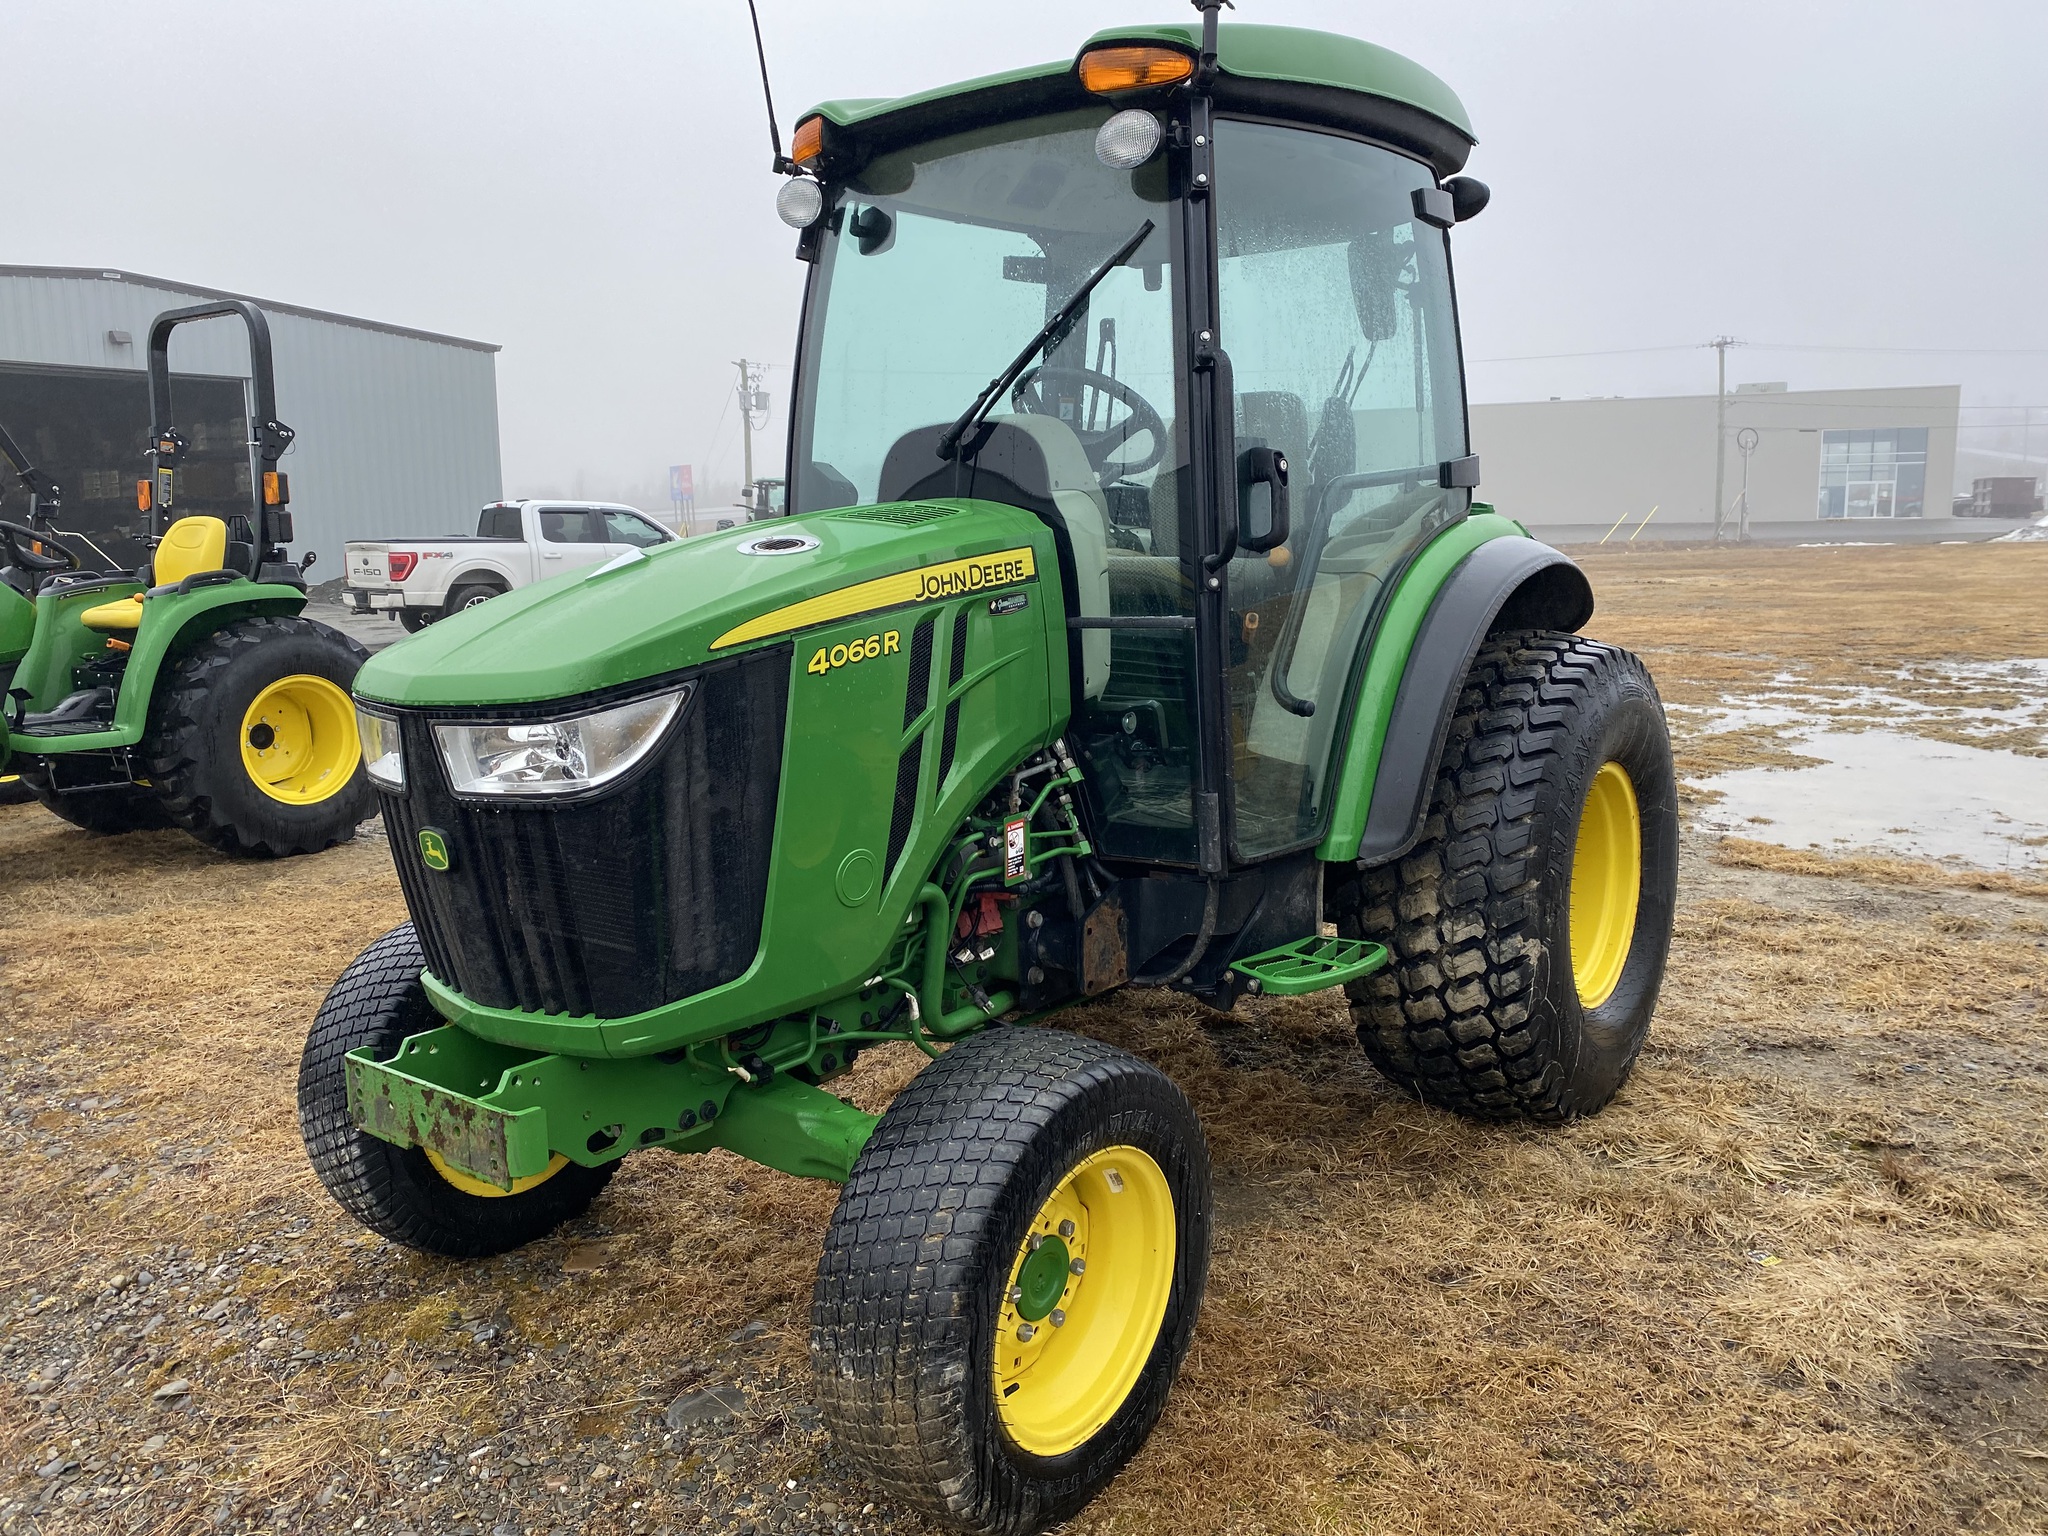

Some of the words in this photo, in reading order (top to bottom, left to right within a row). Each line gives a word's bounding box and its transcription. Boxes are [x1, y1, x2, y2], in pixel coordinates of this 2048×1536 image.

[422, 551, 454, 560] FX4
[353, 568, 382, 576] F-150
[915, 573, 967, 599] JOHN
[969, 560, 1025, 590] DEERE
